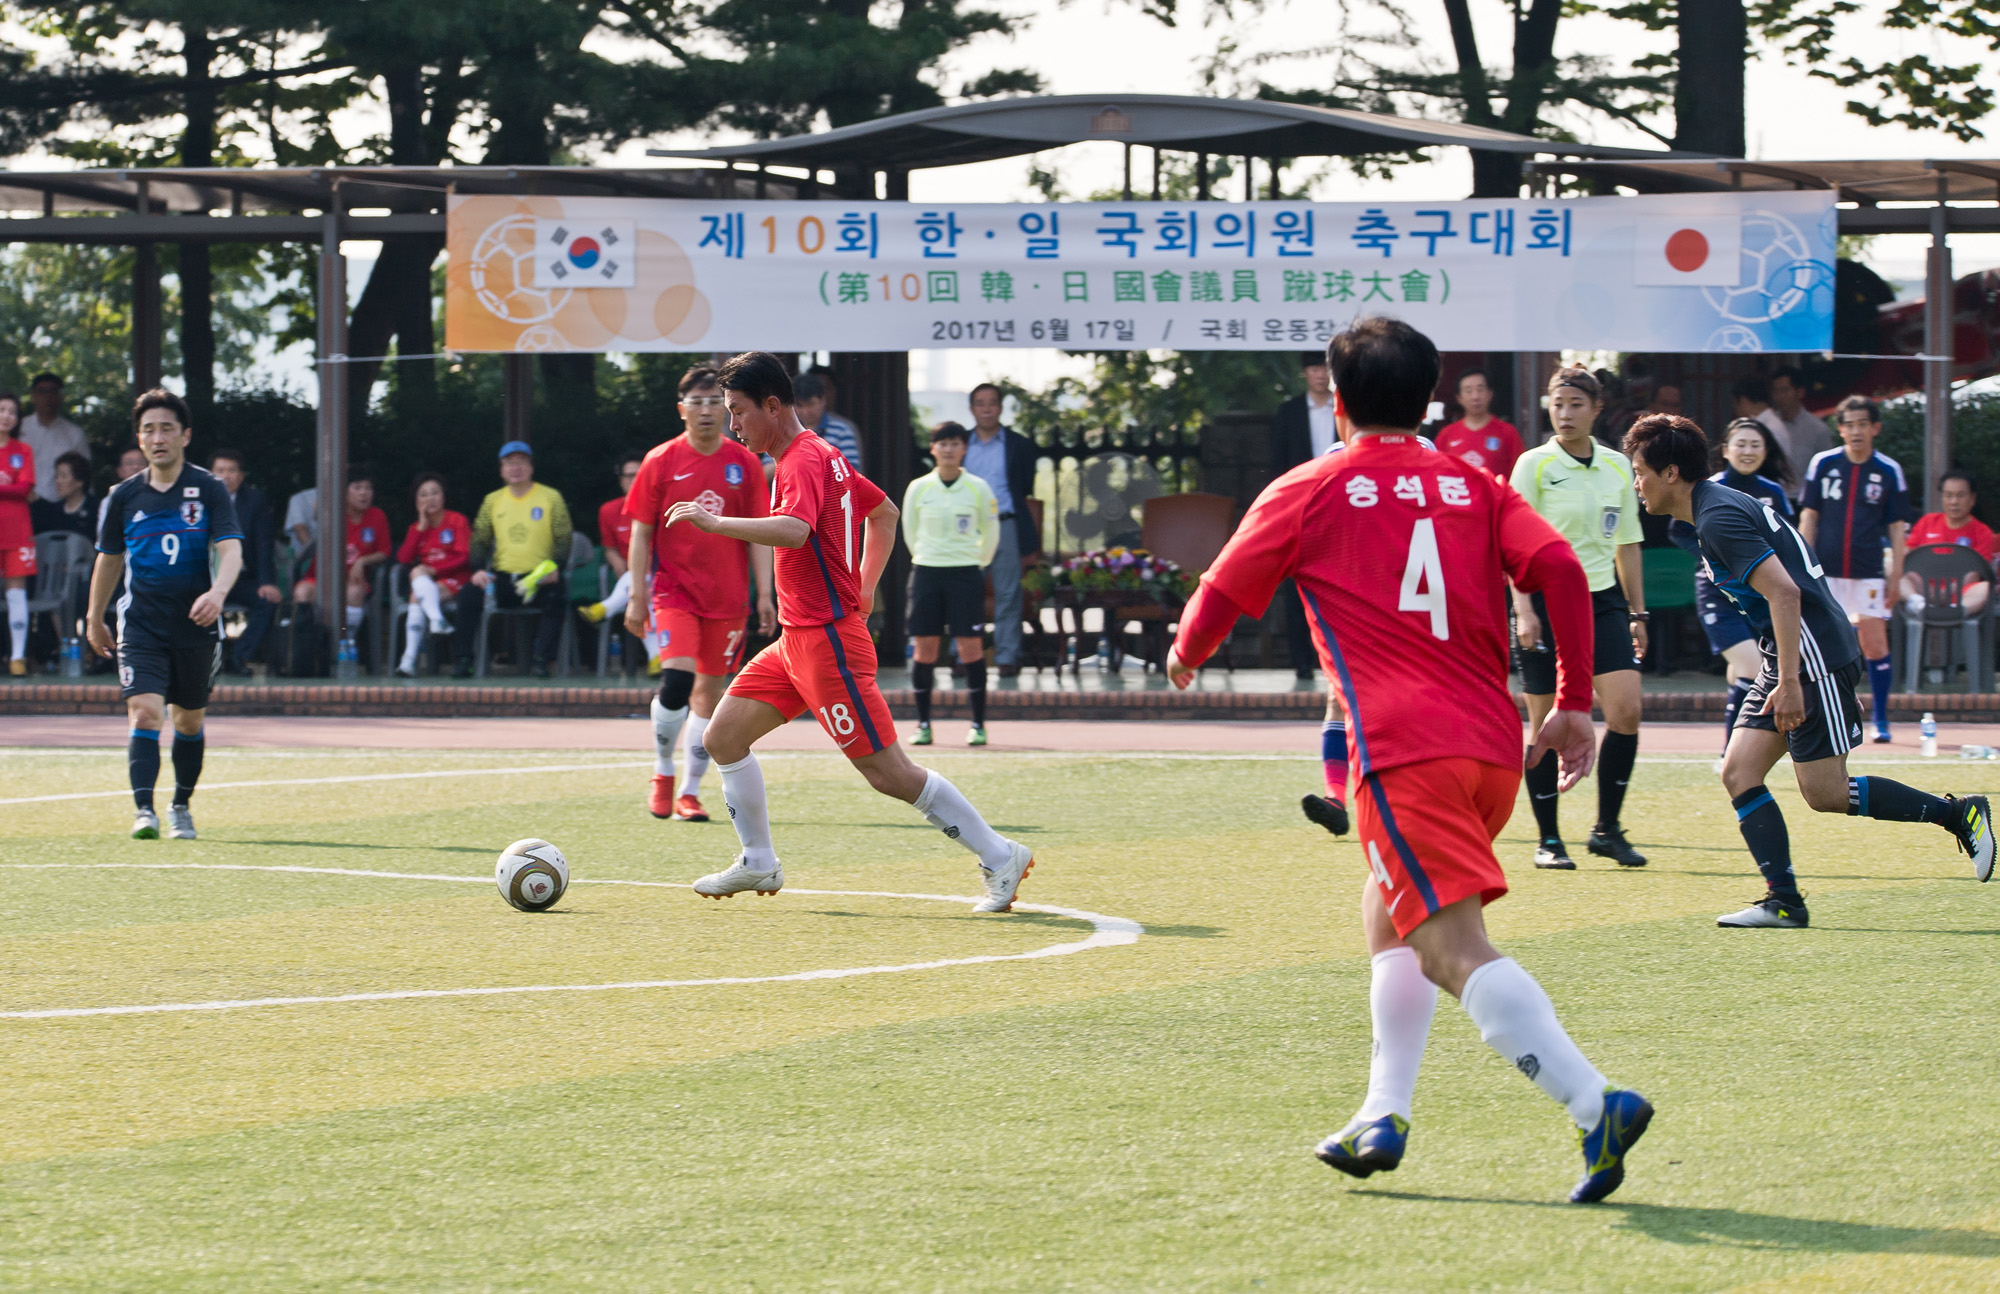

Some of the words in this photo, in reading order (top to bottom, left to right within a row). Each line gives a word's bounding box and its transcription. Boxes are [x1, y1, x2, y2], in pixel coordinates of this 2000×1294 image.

[698, 211, 879, 260] 제10회
[1094, 209, 1316, 259] 국회의원
[1350, 207, 1573, 258] 축구대회
[819, 270, 959, 306] (第10回
[1114, 269, 1259, 303] 國會議員
[1283, 269, 1449, 305] 蹴球大會)
[932, 319, 1015, 342] 2017년
[1030, 318, 1069, 342] 6월
[1084, 319, 1134, 342] 17일
[1200, 319, 1247, 342] 국회
[1820, 477, 1843, 501] 14
[161, 533, 180, 566] 9
[1398, 517, 1450, 641] 4
[819, 703, 855, 737] 18
[1367, 839, 1394, 891] 4
